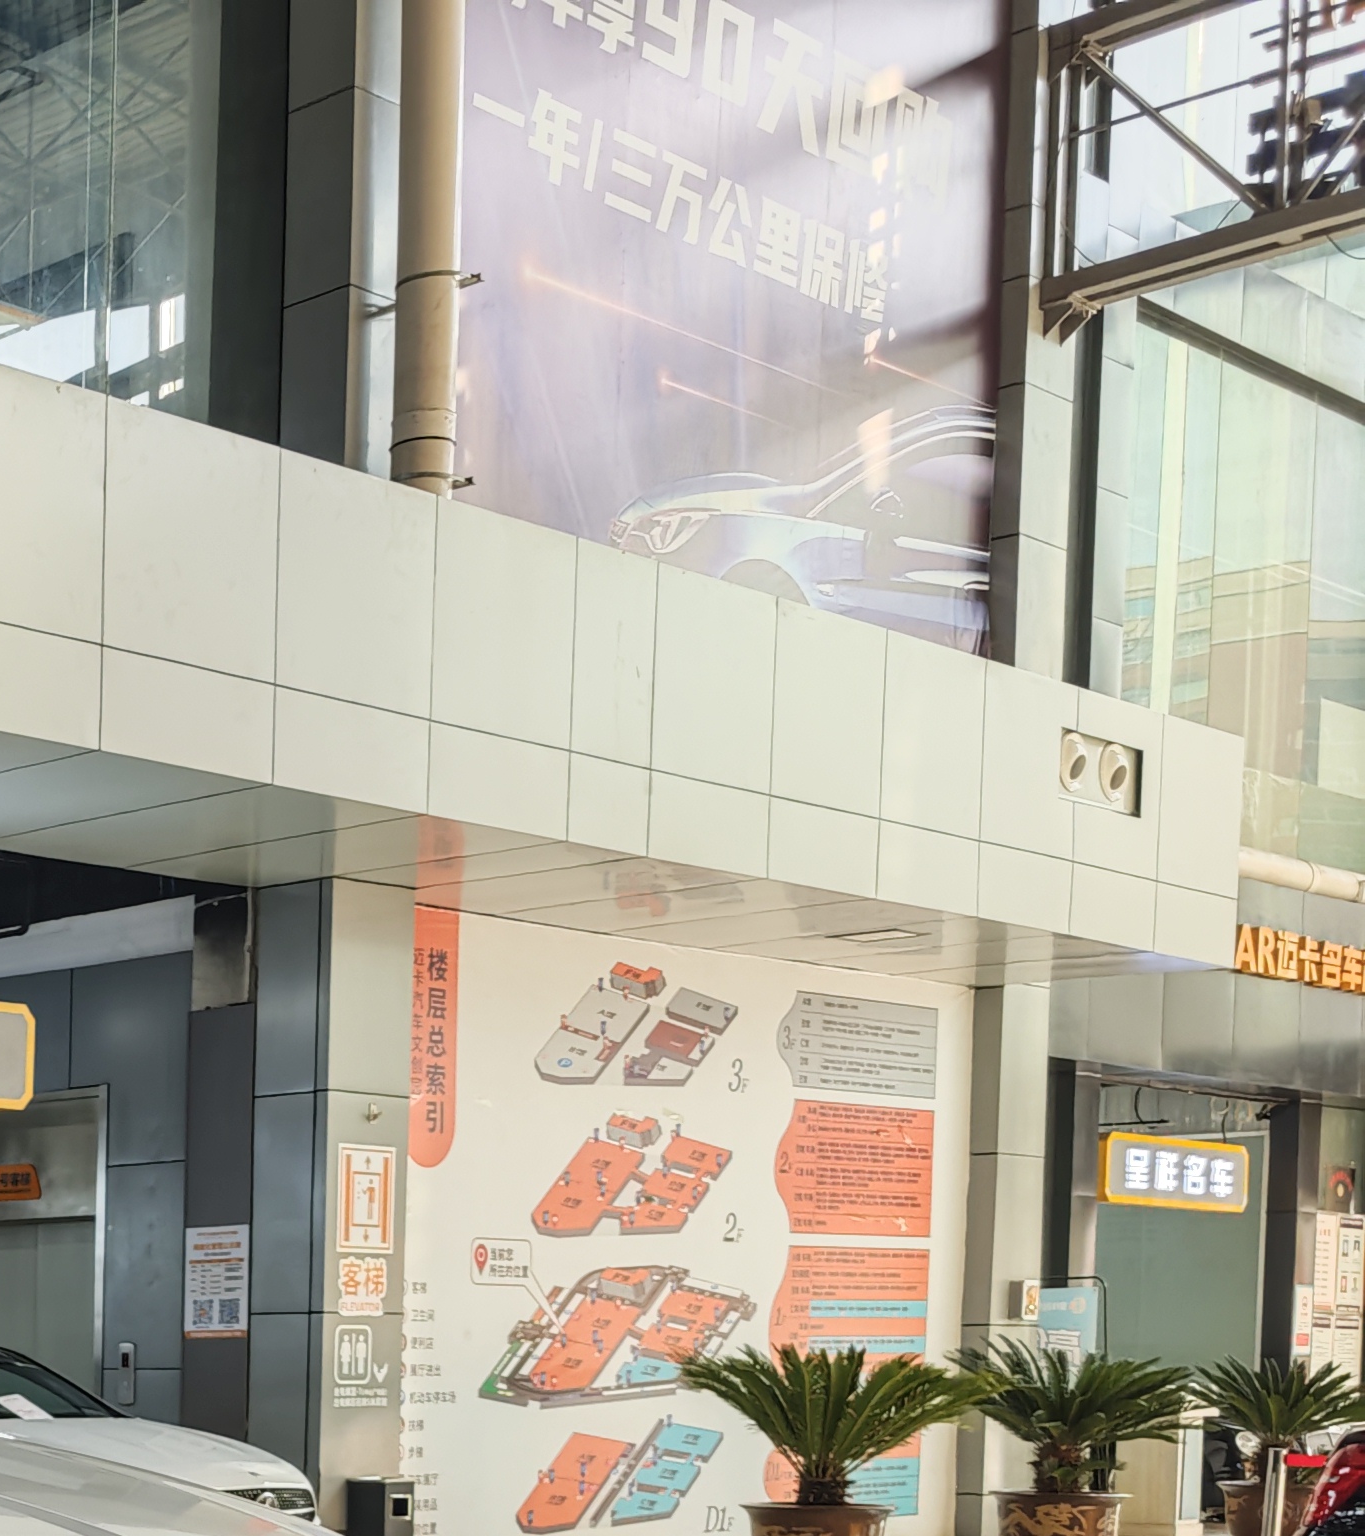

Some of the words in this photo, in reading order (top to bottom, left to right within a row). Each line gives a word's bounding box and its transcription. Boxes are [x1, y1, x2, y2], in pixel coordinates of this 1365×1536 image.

[1235, 922, 1365, 993] AR迈卡名车
[425, 946, 449, 1135] 楼层总索引
[342, 1260, 385, 1297] 客梯
